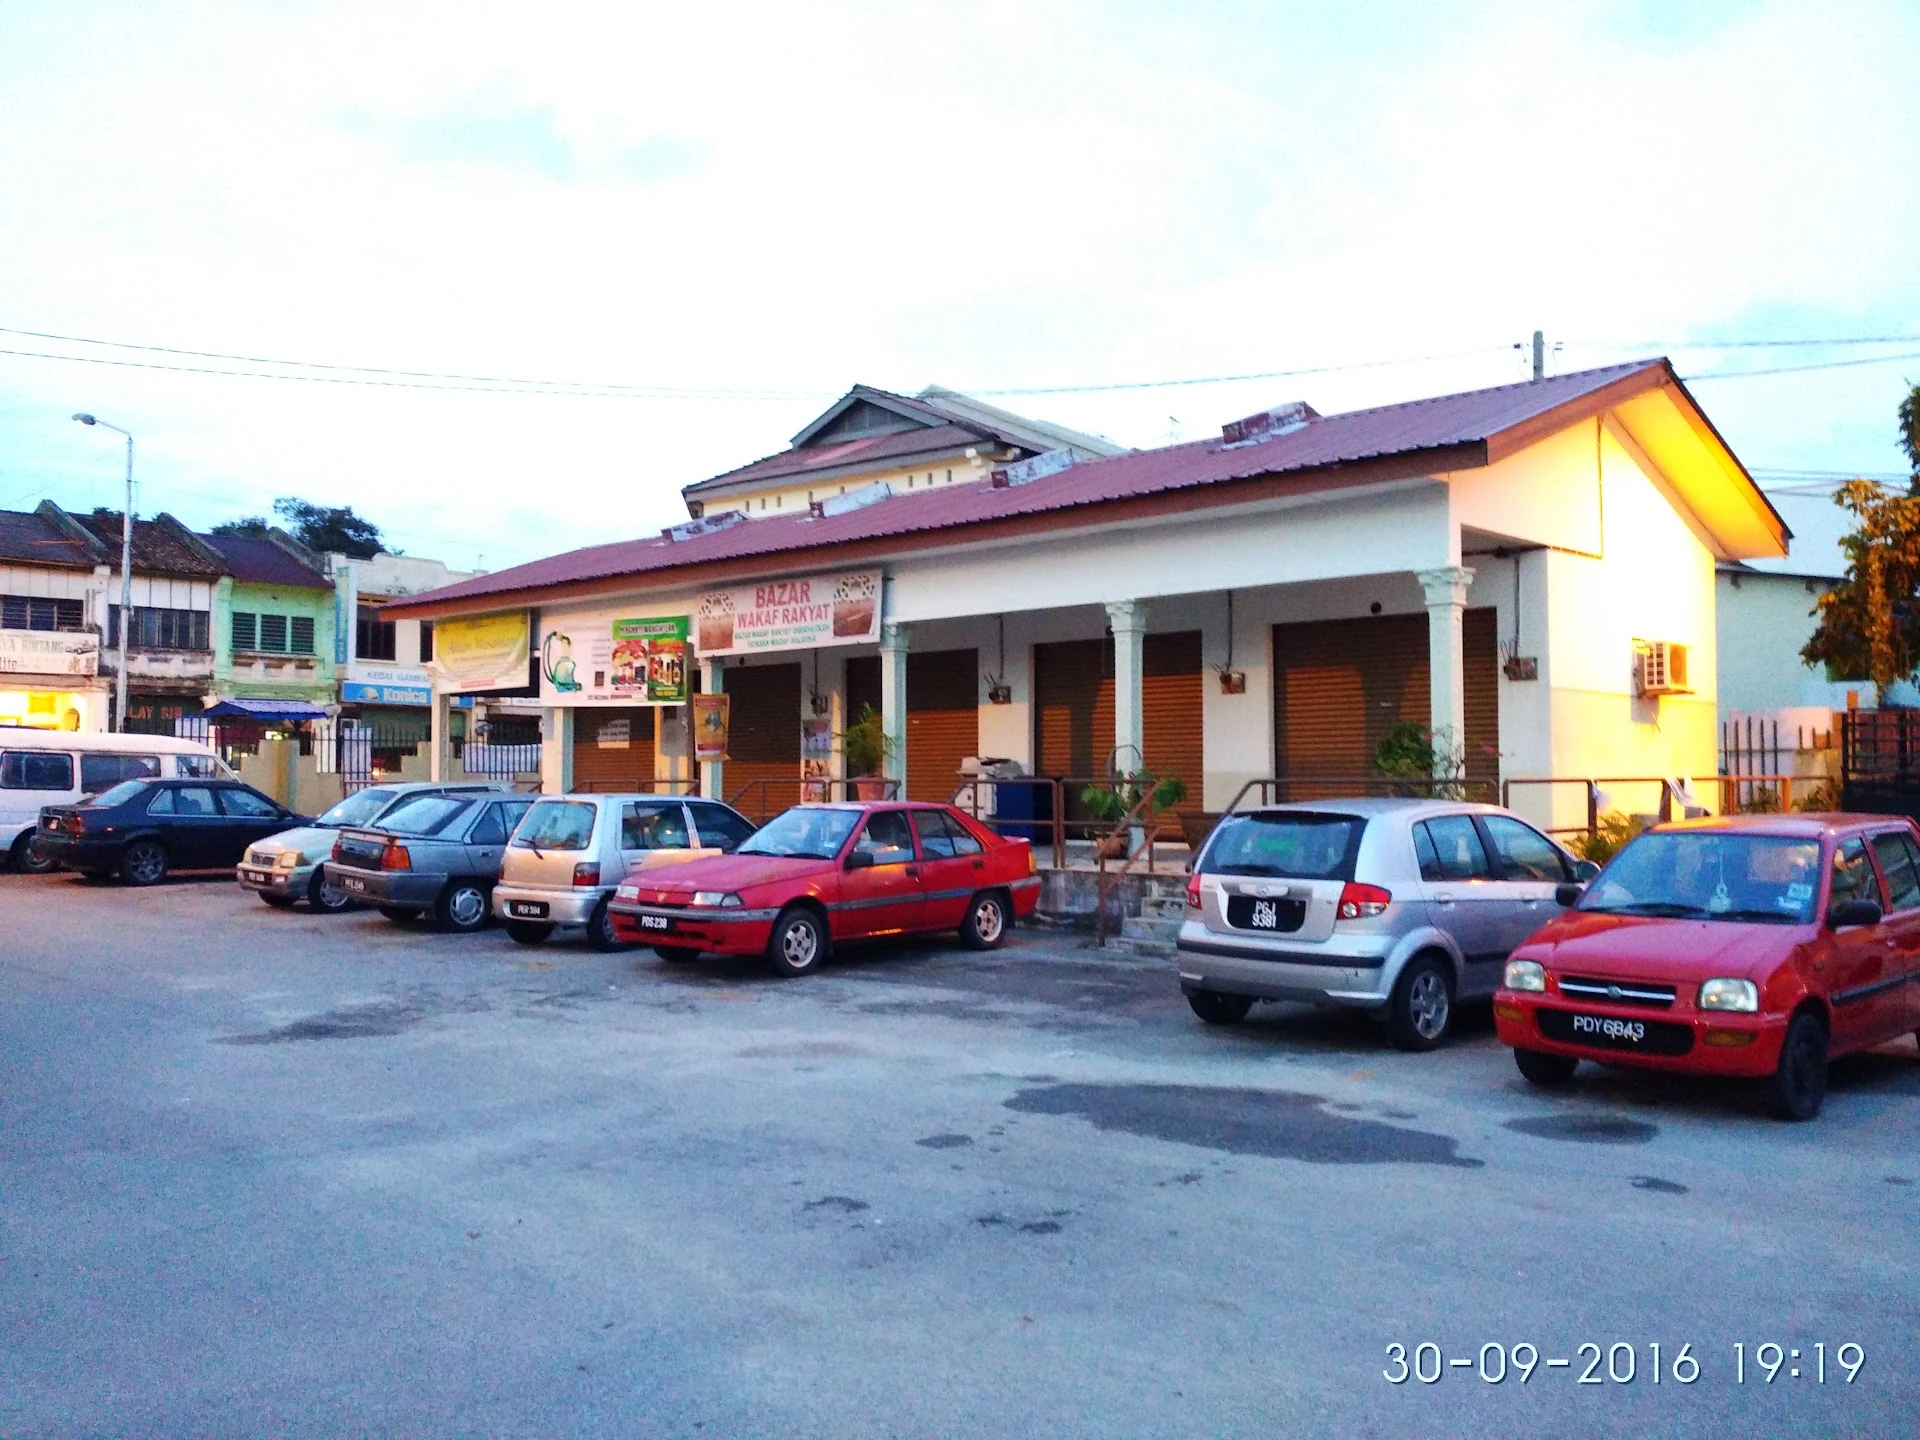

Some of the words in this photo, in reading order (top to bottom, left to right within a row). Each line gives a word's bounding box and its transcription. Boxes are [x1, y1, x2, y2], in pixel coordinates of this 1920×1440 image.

[755, 580, 811, 608] BAZAR
[737, 609, 779, 628] WAKAF
[782, 604, 830, 625] RAKYAT
[383, 687, 428, 703] Konica
